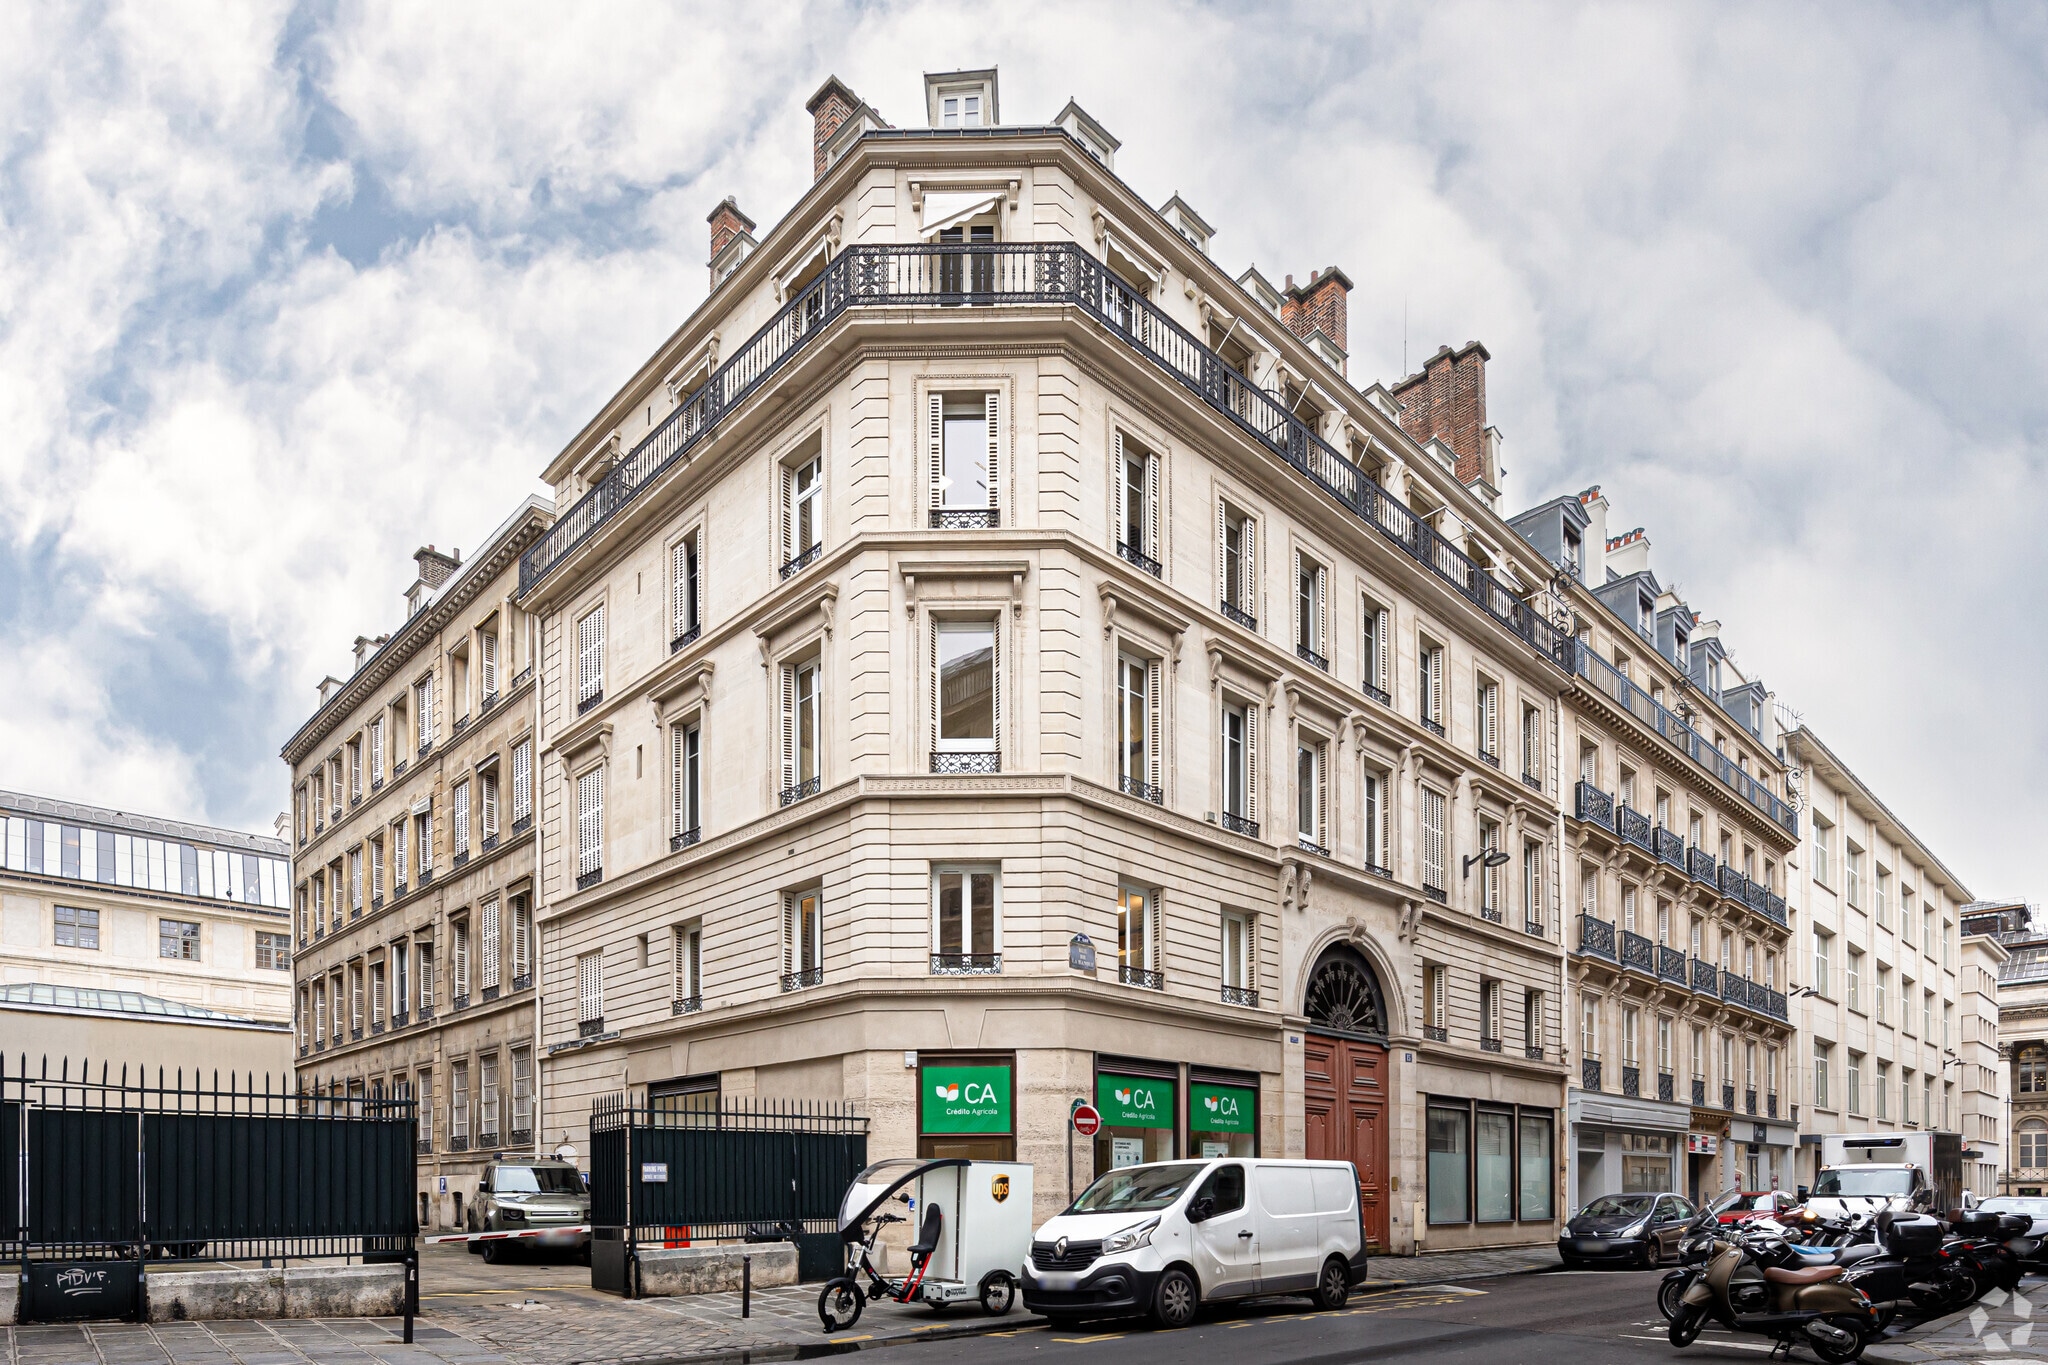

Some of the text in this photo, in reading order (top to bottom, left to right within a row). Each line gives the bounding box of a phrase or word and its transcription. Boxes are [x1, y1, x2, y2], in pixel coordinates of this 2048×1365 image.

[965, 1083, 997, 1104] CA
[1134, 1089, 1155, 1109] CA
[1221, 1097, 1239, 1115] CA
[993, 1183, 1008, 1199] ups
